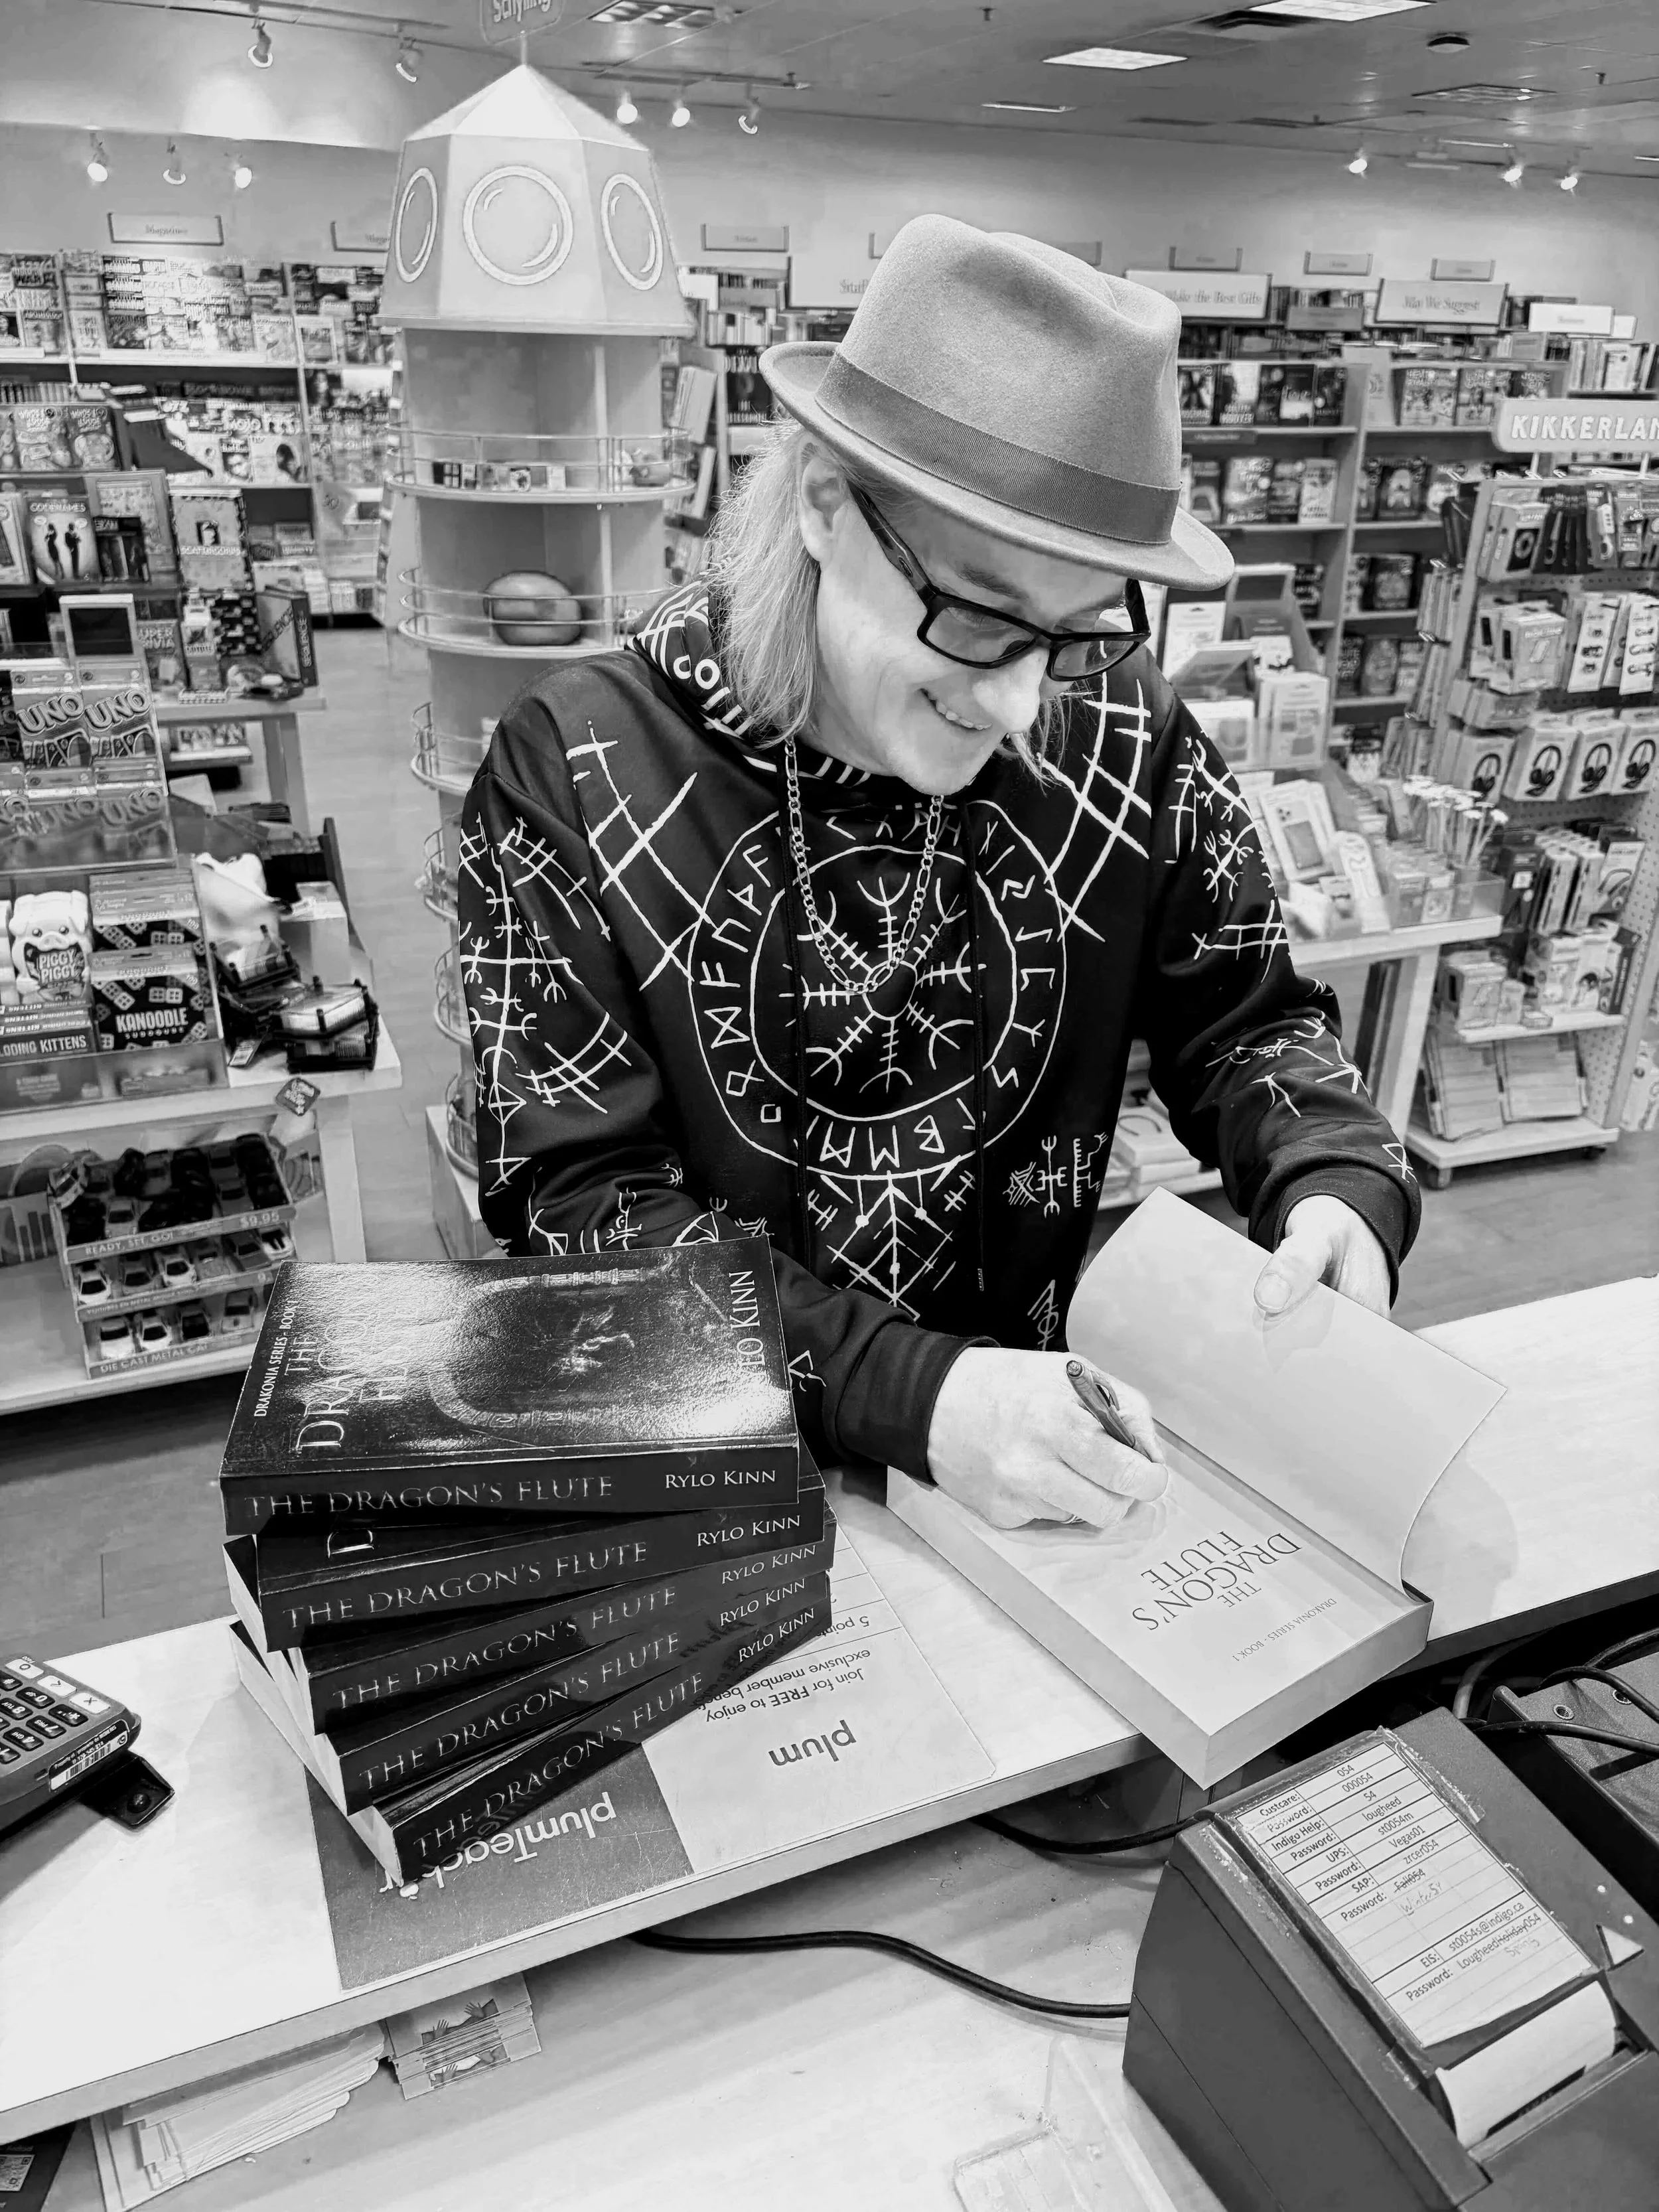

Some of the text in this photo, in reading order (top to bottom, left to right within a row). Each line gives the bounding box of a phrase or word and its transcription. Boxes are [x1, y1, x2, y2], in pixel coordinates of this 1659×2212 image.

[17, 692, 84, 735] UNO
[84, 689, 151, 731] UNO
[39, 948, 75, 970] PIGGY
[40, 964, 78, 986] PIGGY
[115, 1007, 188, 1033] KANOODLE
[40, 1035, 87, 1053] KITTENS
[240, 1211, 280, 1228] $9.95
[729, 1270, 760, 1330] KINN
[253, 1365, 277, 1418] DRAKONIA
[269, 1337, 285, 1366] SERIES
[279, 1309, 297, 1330] BOOK
[285, 1337, 319, 1376] THE
[245, 1469, 776, 1516] THE DRAGON'S FLUTE RYLO KINN
[282, 1514, 800, 1628] THE DRAGON'S FLUTE RYLO KINN
[1132, 1533, 1303, 1631] DRAGON'S
[1141, 1530, 1244, 1590] FLUTE
[1217, 1582, 1262, 1607] THE
[1293, 1597, 1337, 1625] DRAKONIA
[332, 1544, 816, 1710] THE DRAGON'S FLUTE RYLO KINN
[859, 1616, 869, 1627] 5
[1267, 1621, 1295, 1642] SERIES
[809, 1650, 871, 1673] exclusive
[1240, 1640, 1265, 1659] BOOK
[359, 1578, 806, 1789] THE DRAGON'S FLUTE RYLO KINN
[705, 1668, 864, 1722] Join for FREE to enjoy
[747, 1670, 805, 1692] member
[413, 1608, 815, 1858] THE DRAGON'S FLUTE RYLO KINN
[768, 1720, 857, 1766] plum
[1260, 1765, 1354, 1817] Custcare: 054
[1342, 1772, 1374, 1793] 000054
[1271, 1790, 1377, 1852] Indigo Help: 54
[1290, 1797, 1402, 1862] Password: lougheed
[1327, 1811, 1414, 1863] UPS: st0054m
[1315, 1824, 1425, 1891] Password: Vegas01
[1352, 1839, 1439, 1893] SAP: zrcer054
[1341, 1892, 1387, 1921] Password:
[1420, 1901, 1524, 1968] EIS: st0054s@indigo.ca
[1406, 1968, 1453, 2001] Password:
